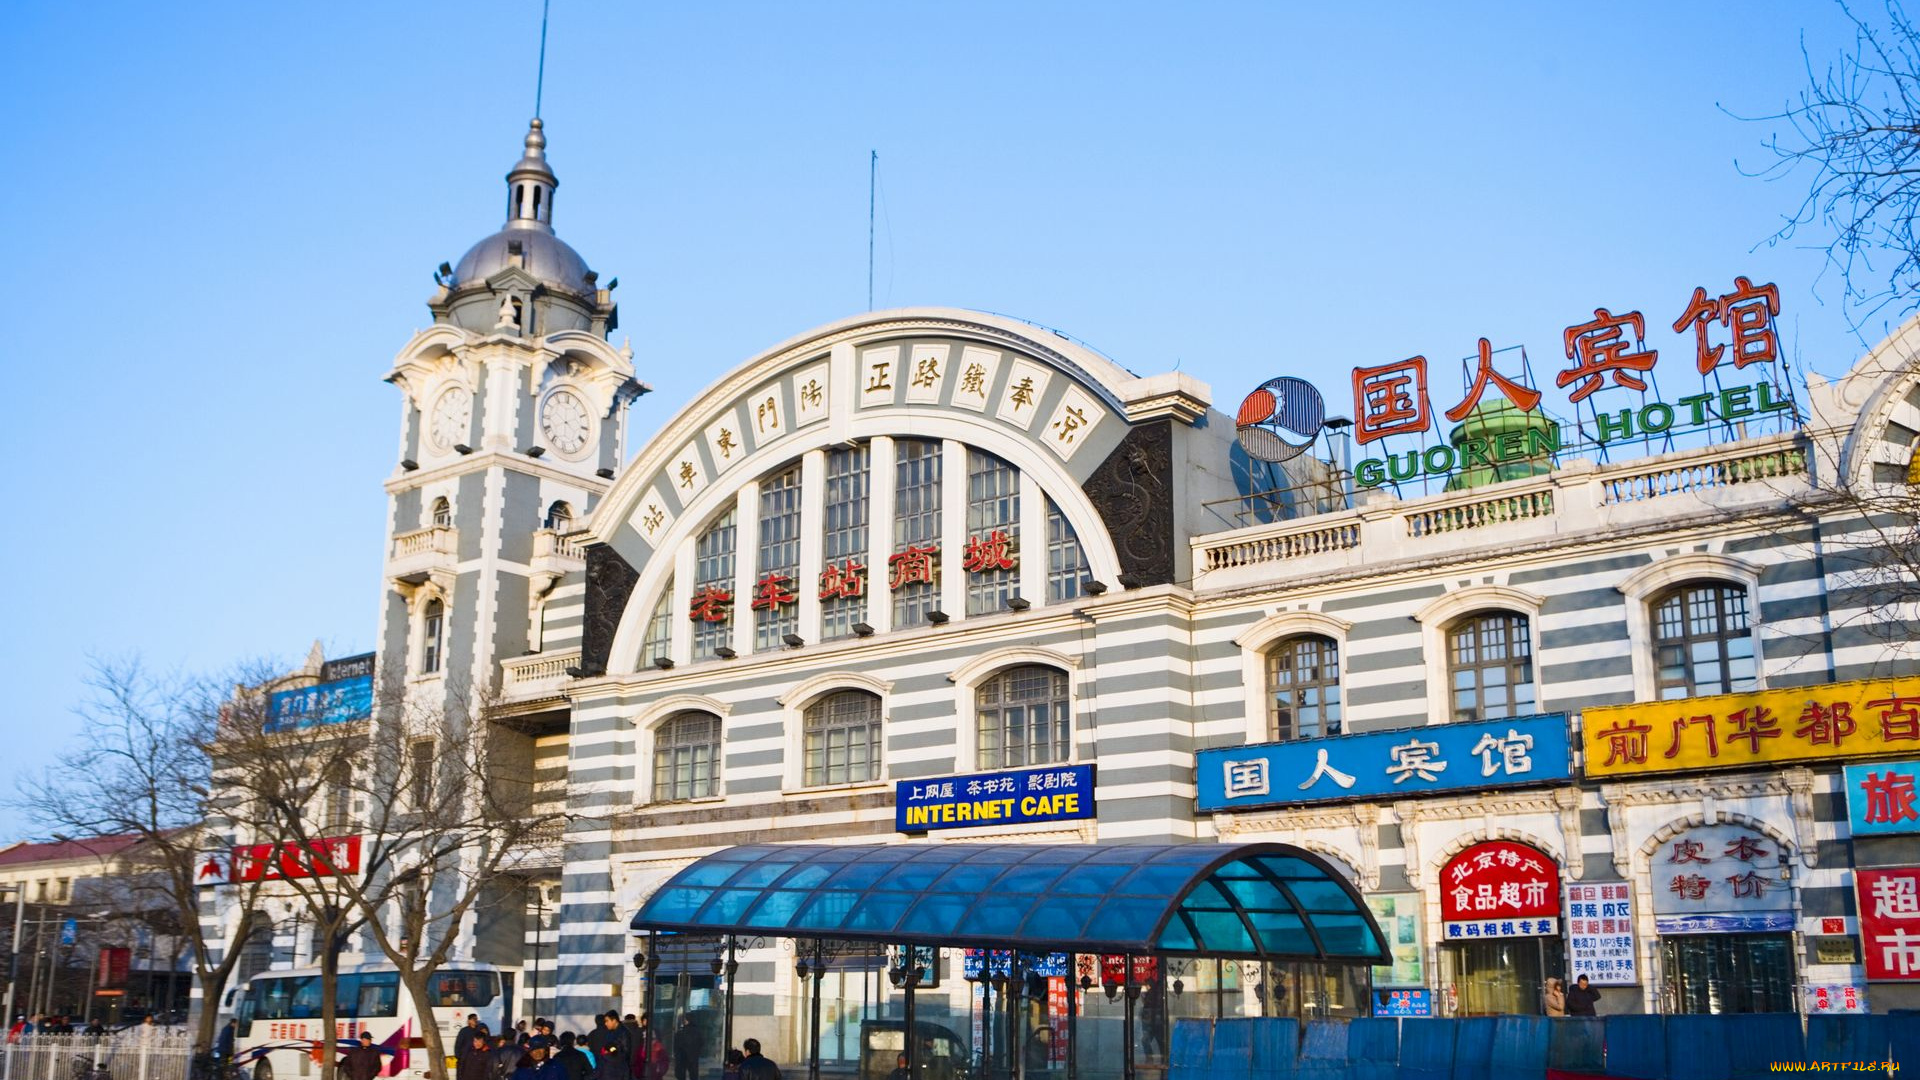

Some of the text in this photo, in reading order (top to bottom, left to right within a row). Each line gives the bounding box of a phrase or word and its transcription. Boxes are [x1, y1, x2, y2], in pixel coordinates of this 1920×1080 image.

[1352, 276, 1781, 446] 国人宾馆
[1353, 381, 1791, 488] GUOREN HOTEL
[688, 529, 1017, 623] 老车站商城
[1595, 696, 1920, 767] 前门华都百
[1222, 728, 1534, 800] 国人宾馆
[908, 771, 1078, 801] 上网屋 茶书苑 影剧院
[1860, 770, 1920, 825] 旅
[905, 793, 1080, 825] INTERNET CAFE
[1450, 849, 1545, 885] 北京特产
[1668, 835, 1770, 865] 皮衣
[1450, 877, 1549, 913] 食品超市
[1669, 870, 1772, 900] 特价
[1570, 902, 1630, 917] 服装 内衣
[1571, 919, 1631, 934] 照相器材
[1448, 919, 1552, 937] 数码相机专卖
[1574, 959, 1633, 971] 手机 相机 手表
